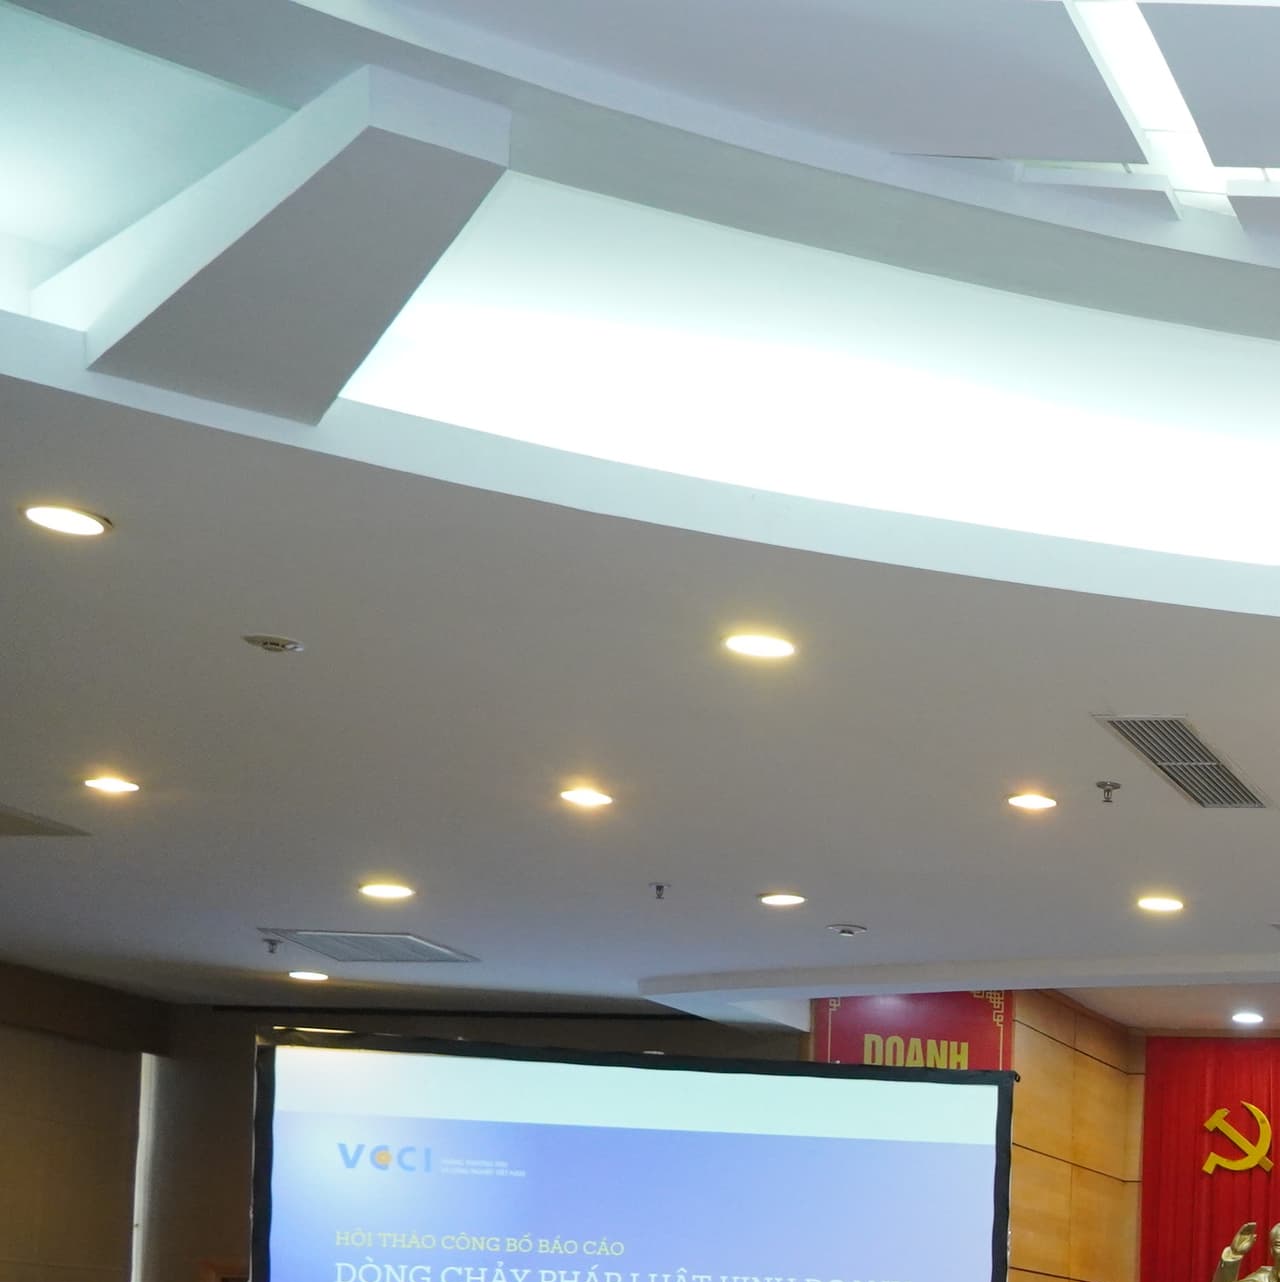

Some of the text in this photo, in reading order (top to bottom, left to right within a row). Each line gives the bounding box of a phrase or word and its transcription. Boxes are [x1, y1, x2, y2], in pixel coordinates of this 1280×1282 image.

[864, 1034, 968, 1070] DOANH
[337, 1143, 431, 1172] VCCI
[441, 1230, 501, 1252] CÔNG
[506, 1232, 532, 1253] BỐ
[538, 1235, 578, 1254] BÁO
[583, 1236, 624, 1256] CÁO
